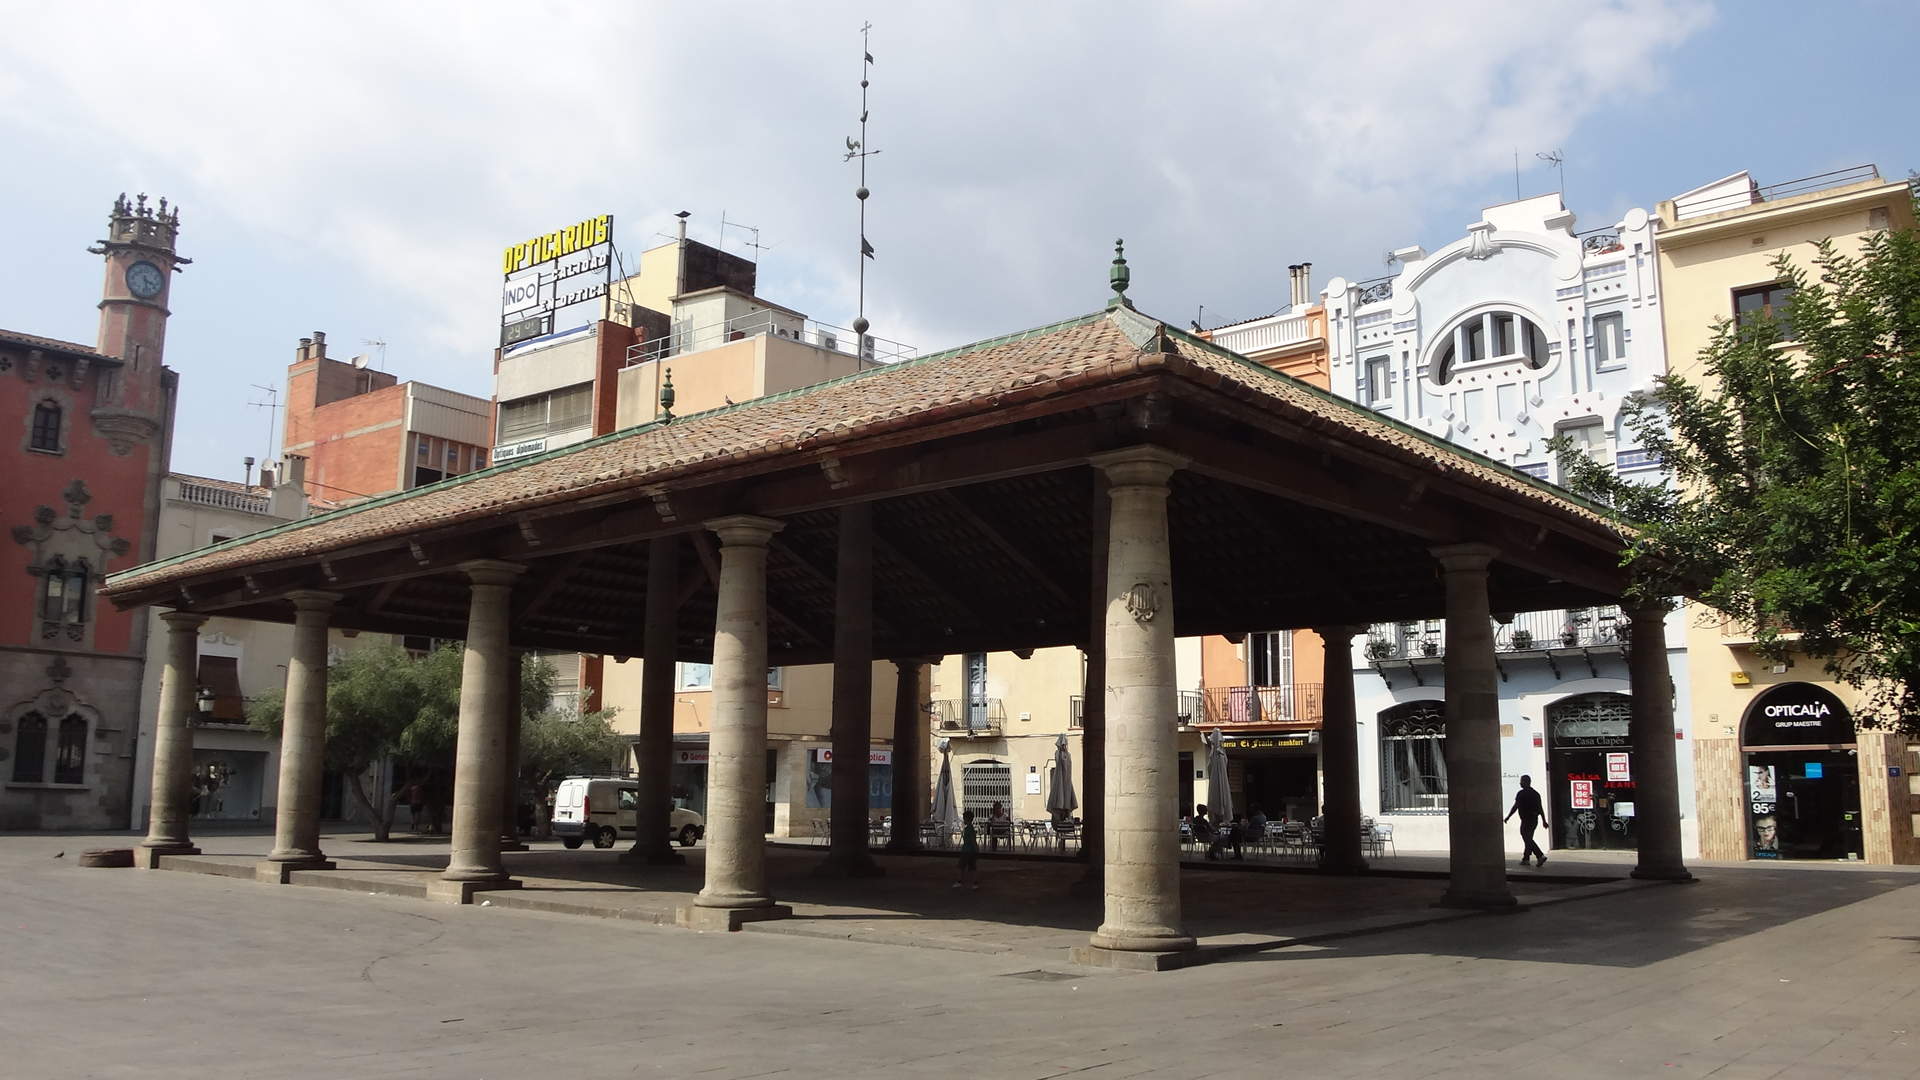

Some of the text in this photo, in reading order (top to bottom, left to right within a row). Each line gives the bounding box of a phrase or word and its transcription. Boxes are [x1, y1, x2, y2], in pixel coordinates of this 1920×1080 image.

[503, 215, 609, 275] OPTICARIUS
[551, 255, 608, 279] CALIDAD
[505, 283, 536, 306] INDO
[560, 283, 607, 306] OPTICA
[1574, 736, 1595, 745] Casa
[1752, 790, 1761, 801] 2
[1752, 803, 1776, 814] 95€
